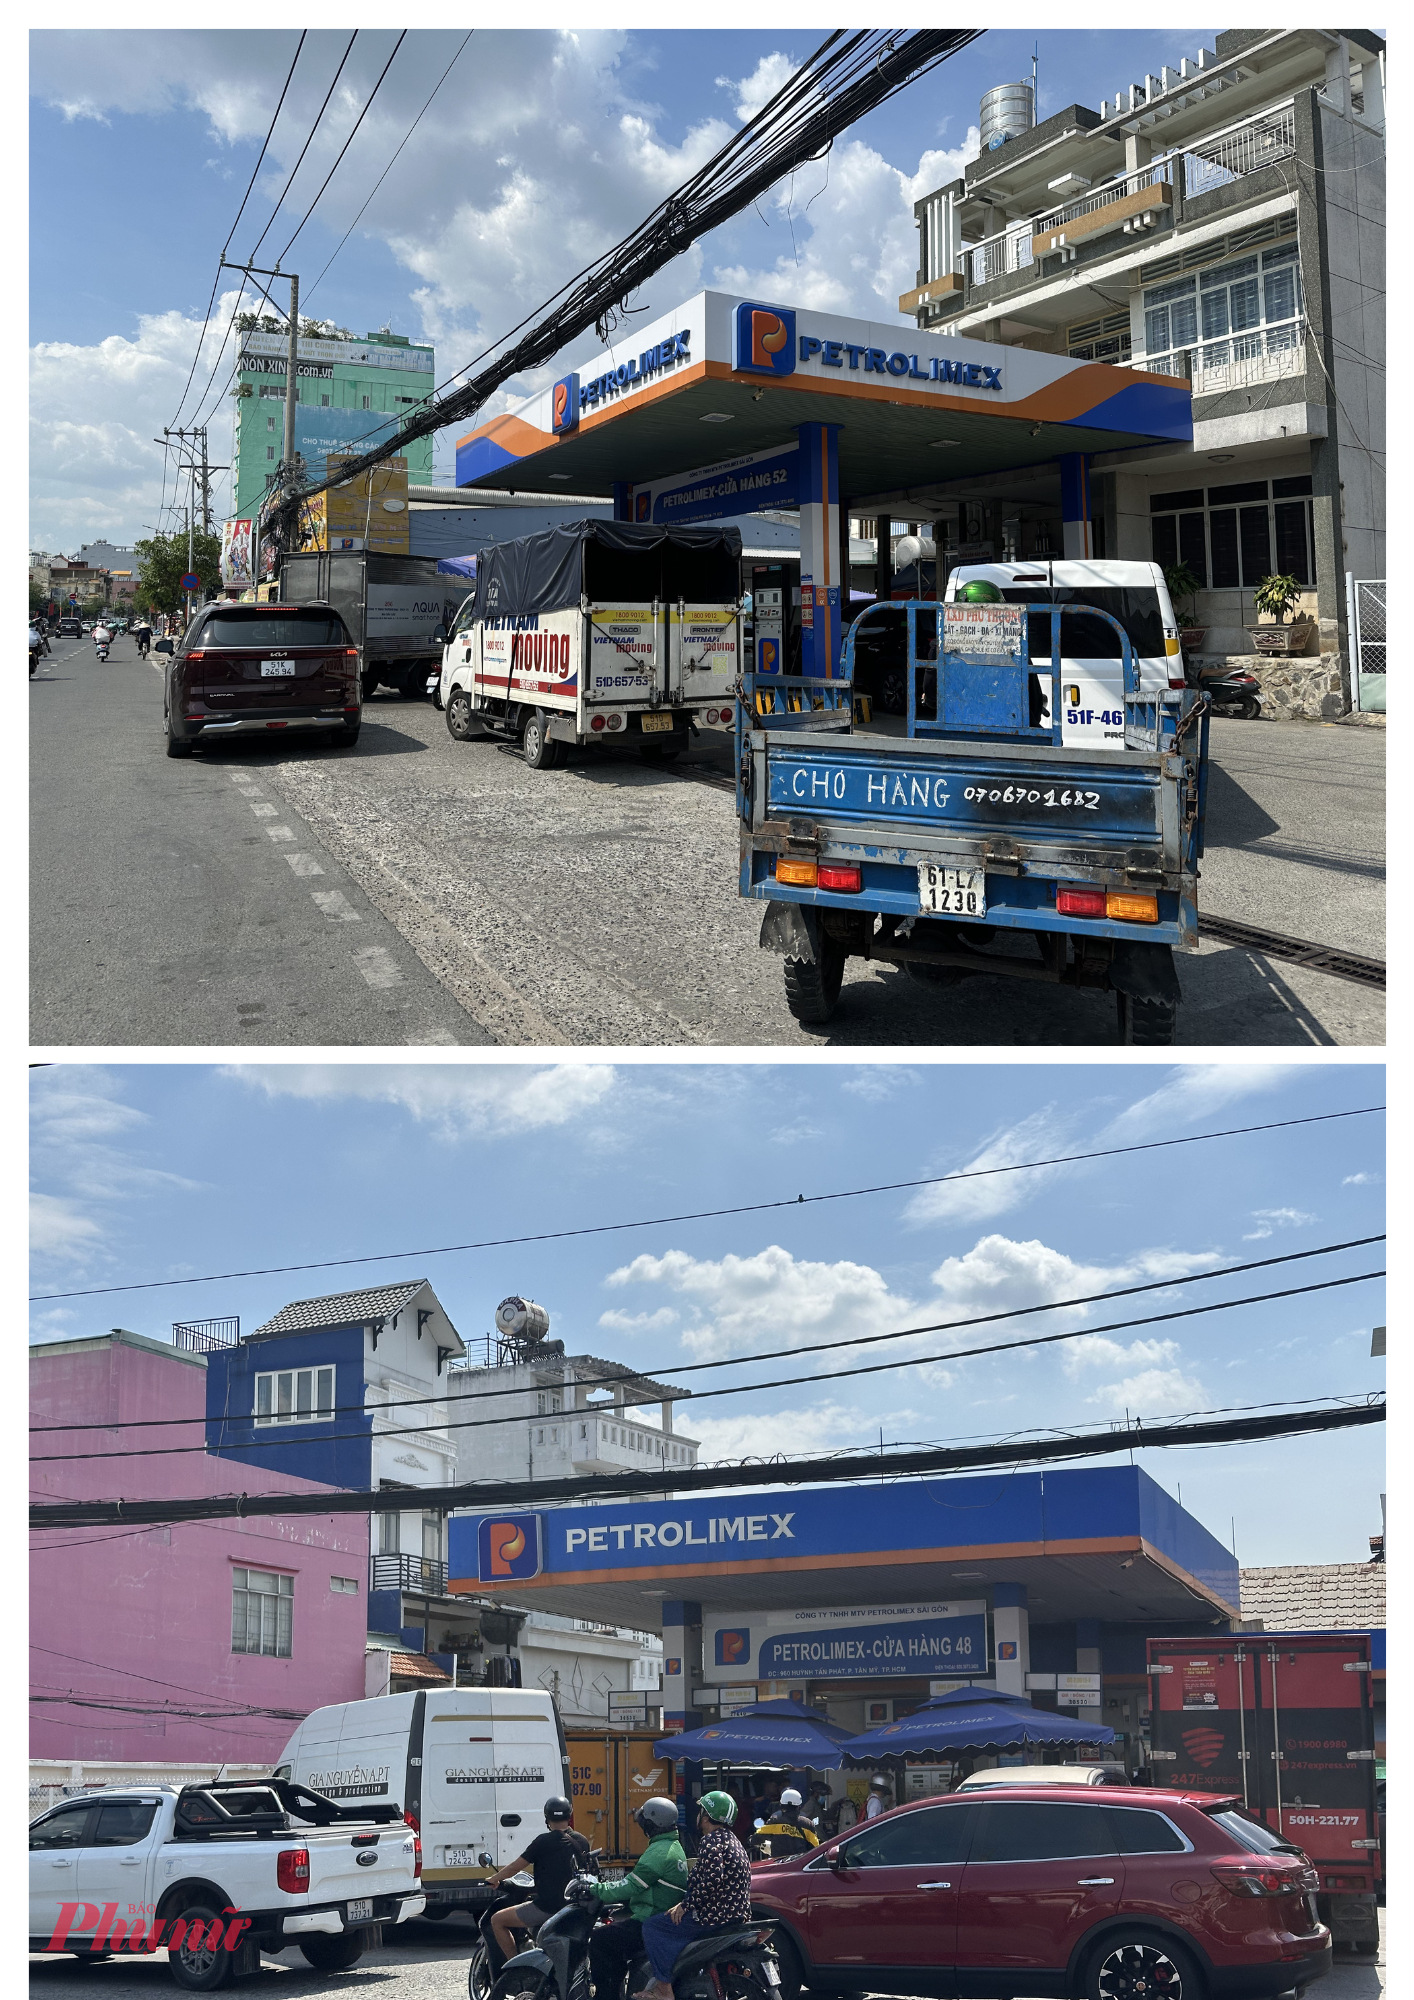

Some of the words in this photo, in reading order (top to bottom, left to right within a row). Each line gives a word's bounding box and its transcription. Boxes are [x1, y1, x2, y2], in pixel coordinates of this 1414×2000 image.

[241, 355, 265, 372] NÓN
[579, 329, 691, 407] PETROLIMEX
[799, 335, 1003, 390] PETROLIMEX
[302, 437, 318, 445] CHO
[319, 437, 338, 446] THUÊ
[740, 472, 772, 492] HÀNG
[772, 468, 788, 484] 52
[412, 602, 440, 613] AQUA
[594, 636, 635, 644] VIETNAM
[616, 642, 652, 653] moving
[703, 642, 735, 652] moving
[512, 628, 570, 679] moving
[1067, 710, 1124, 725] 51F-46
[868, 773, 950, 809] HÀNG
[964, 784, 1100, 810] 0706701682
[566, 1512, 796, 1554] PETROLIMEX
[829, 1610, 849, 1618] TNHH
[867, 1607, 915, 1616] PETROLIMEX
[916, 1606, 929, 1614] SÀI
[930, 1604, 948, 1613] GÒN
[908, 1634, 951, 1656] HÀNG
[955, 1636, 972, 1654] 48
[791, 1668, 814, 1676] HUỲNH
[814, 1666, 828, 1675] TẤN
[855, 1666, 867, 1674] TÂN
[906, 1716, 995, 1731] PETROLIMEX
[724, 1734, 812, 1743] PETROLIMEX
[1298, 1740, 1321, 1748] 1900
[1324, 1740, 1347, 1748] 6980
[1291, 1762, 1357, 1770] 247express.vn
[308, 1770, 324, 1787] GIA
[445, 1768, 466, 1777] GIA
[572, 1766, 591, 1779] 51C
[1171, 1774, 1240, 1786] 247Express
[345, 1784, 381, 1796] production
[572, 1783, 602, 1796] 87.90
[1289, 1816, 1359, 1826] 50H-221.77
[453, 1850, 466, 1858] 51D
[449, 1857, 472, 1865] 724.22
[354, 1901, 366, 1910] 51D
